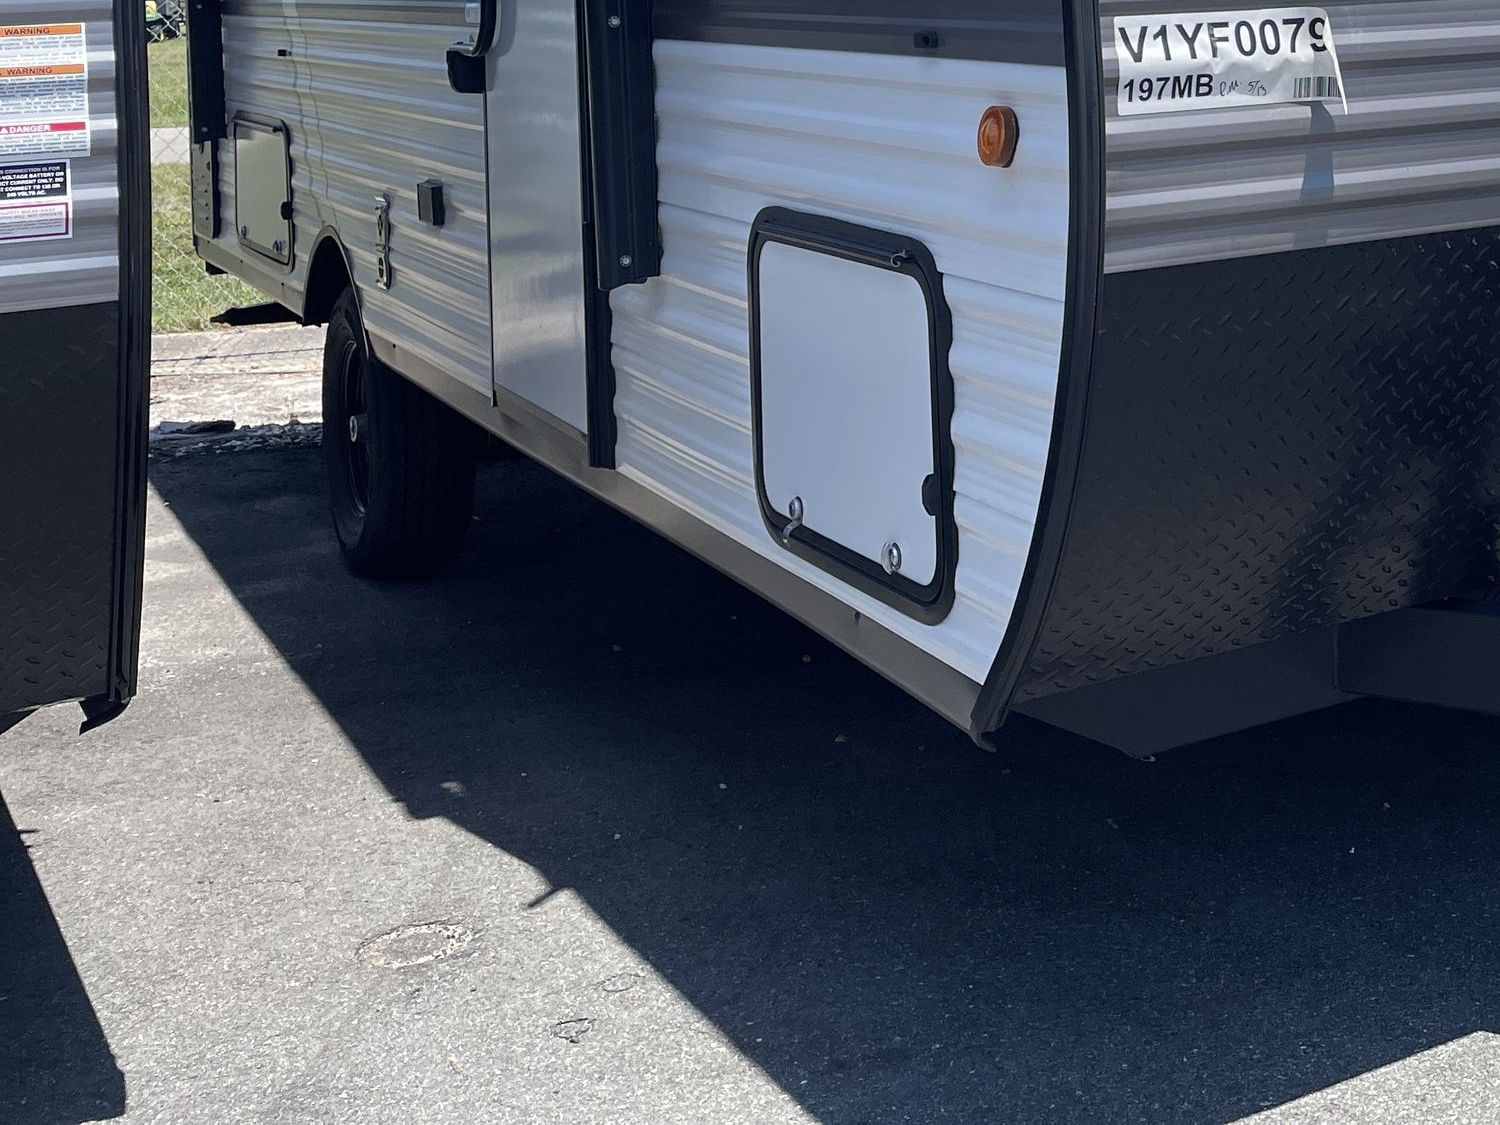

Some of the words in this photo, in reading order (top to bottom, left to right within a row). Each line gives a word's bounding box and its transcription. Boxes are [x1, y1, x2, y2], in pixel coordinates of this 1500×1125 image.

[4, 27, 50, 36] WARNING
[1118, 17, 1327, 63] V1YF0079
[7, 66, 53, 75] WARNING
[1123, 73, 1213, 102] 197MB
[9, 123, 51, 134] DANGER
